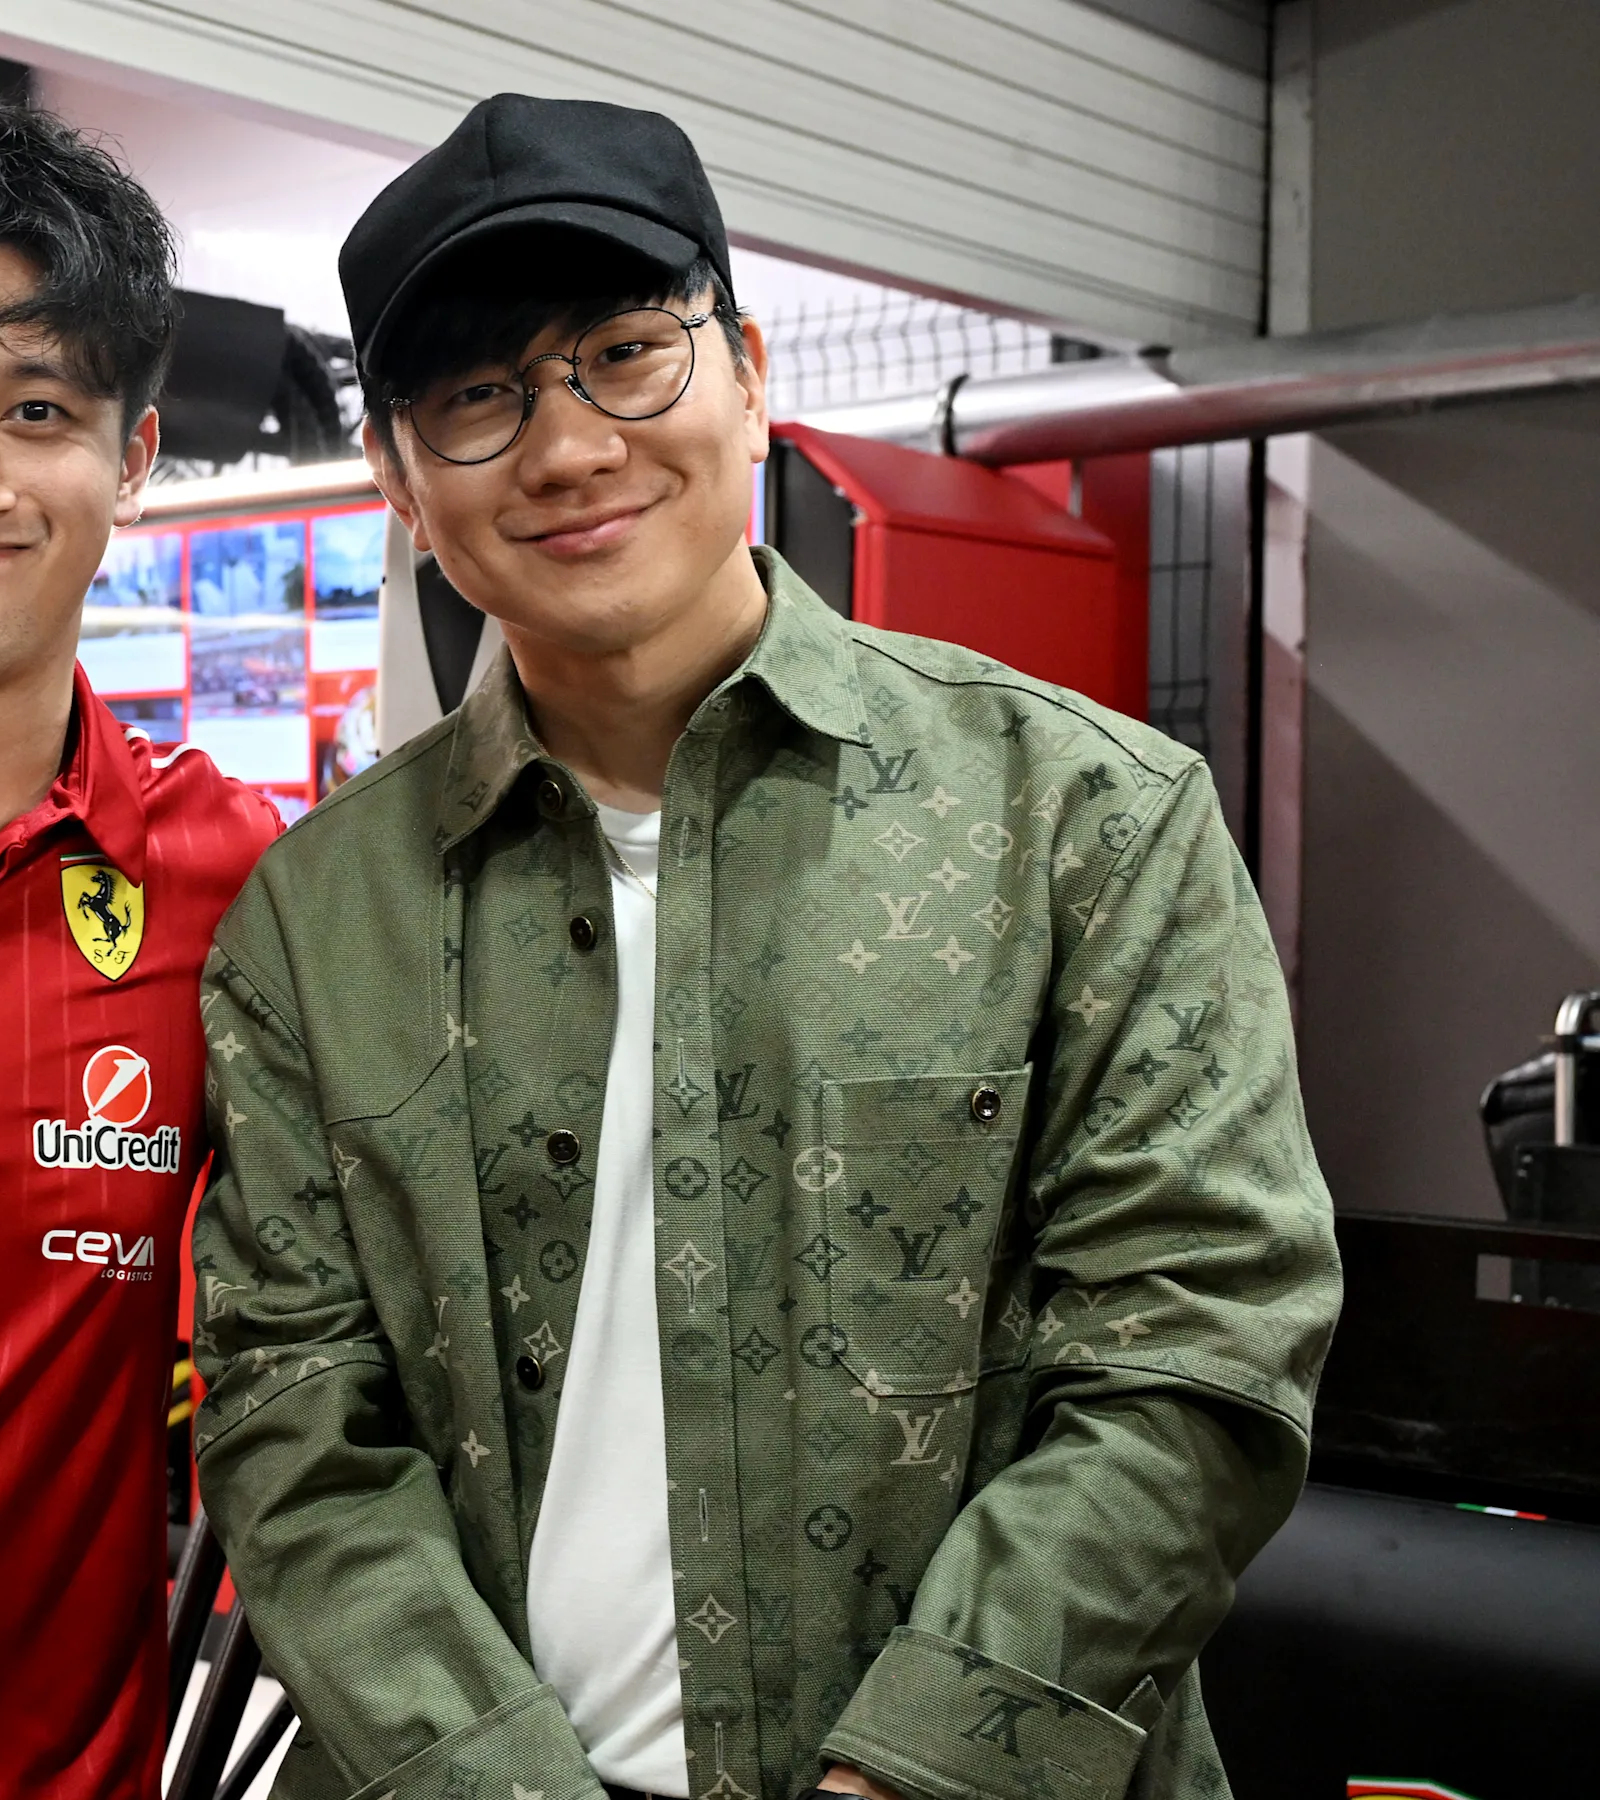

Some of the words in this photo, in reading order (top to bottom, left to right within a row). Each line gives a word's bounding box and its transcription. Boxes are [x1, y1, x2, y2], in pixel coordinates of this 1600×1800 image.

[93, 948, 105, 964] S
[36, 1122, 180, 1171] UniCredit
[101, 1268, 153, 1281] LOGISTICS
